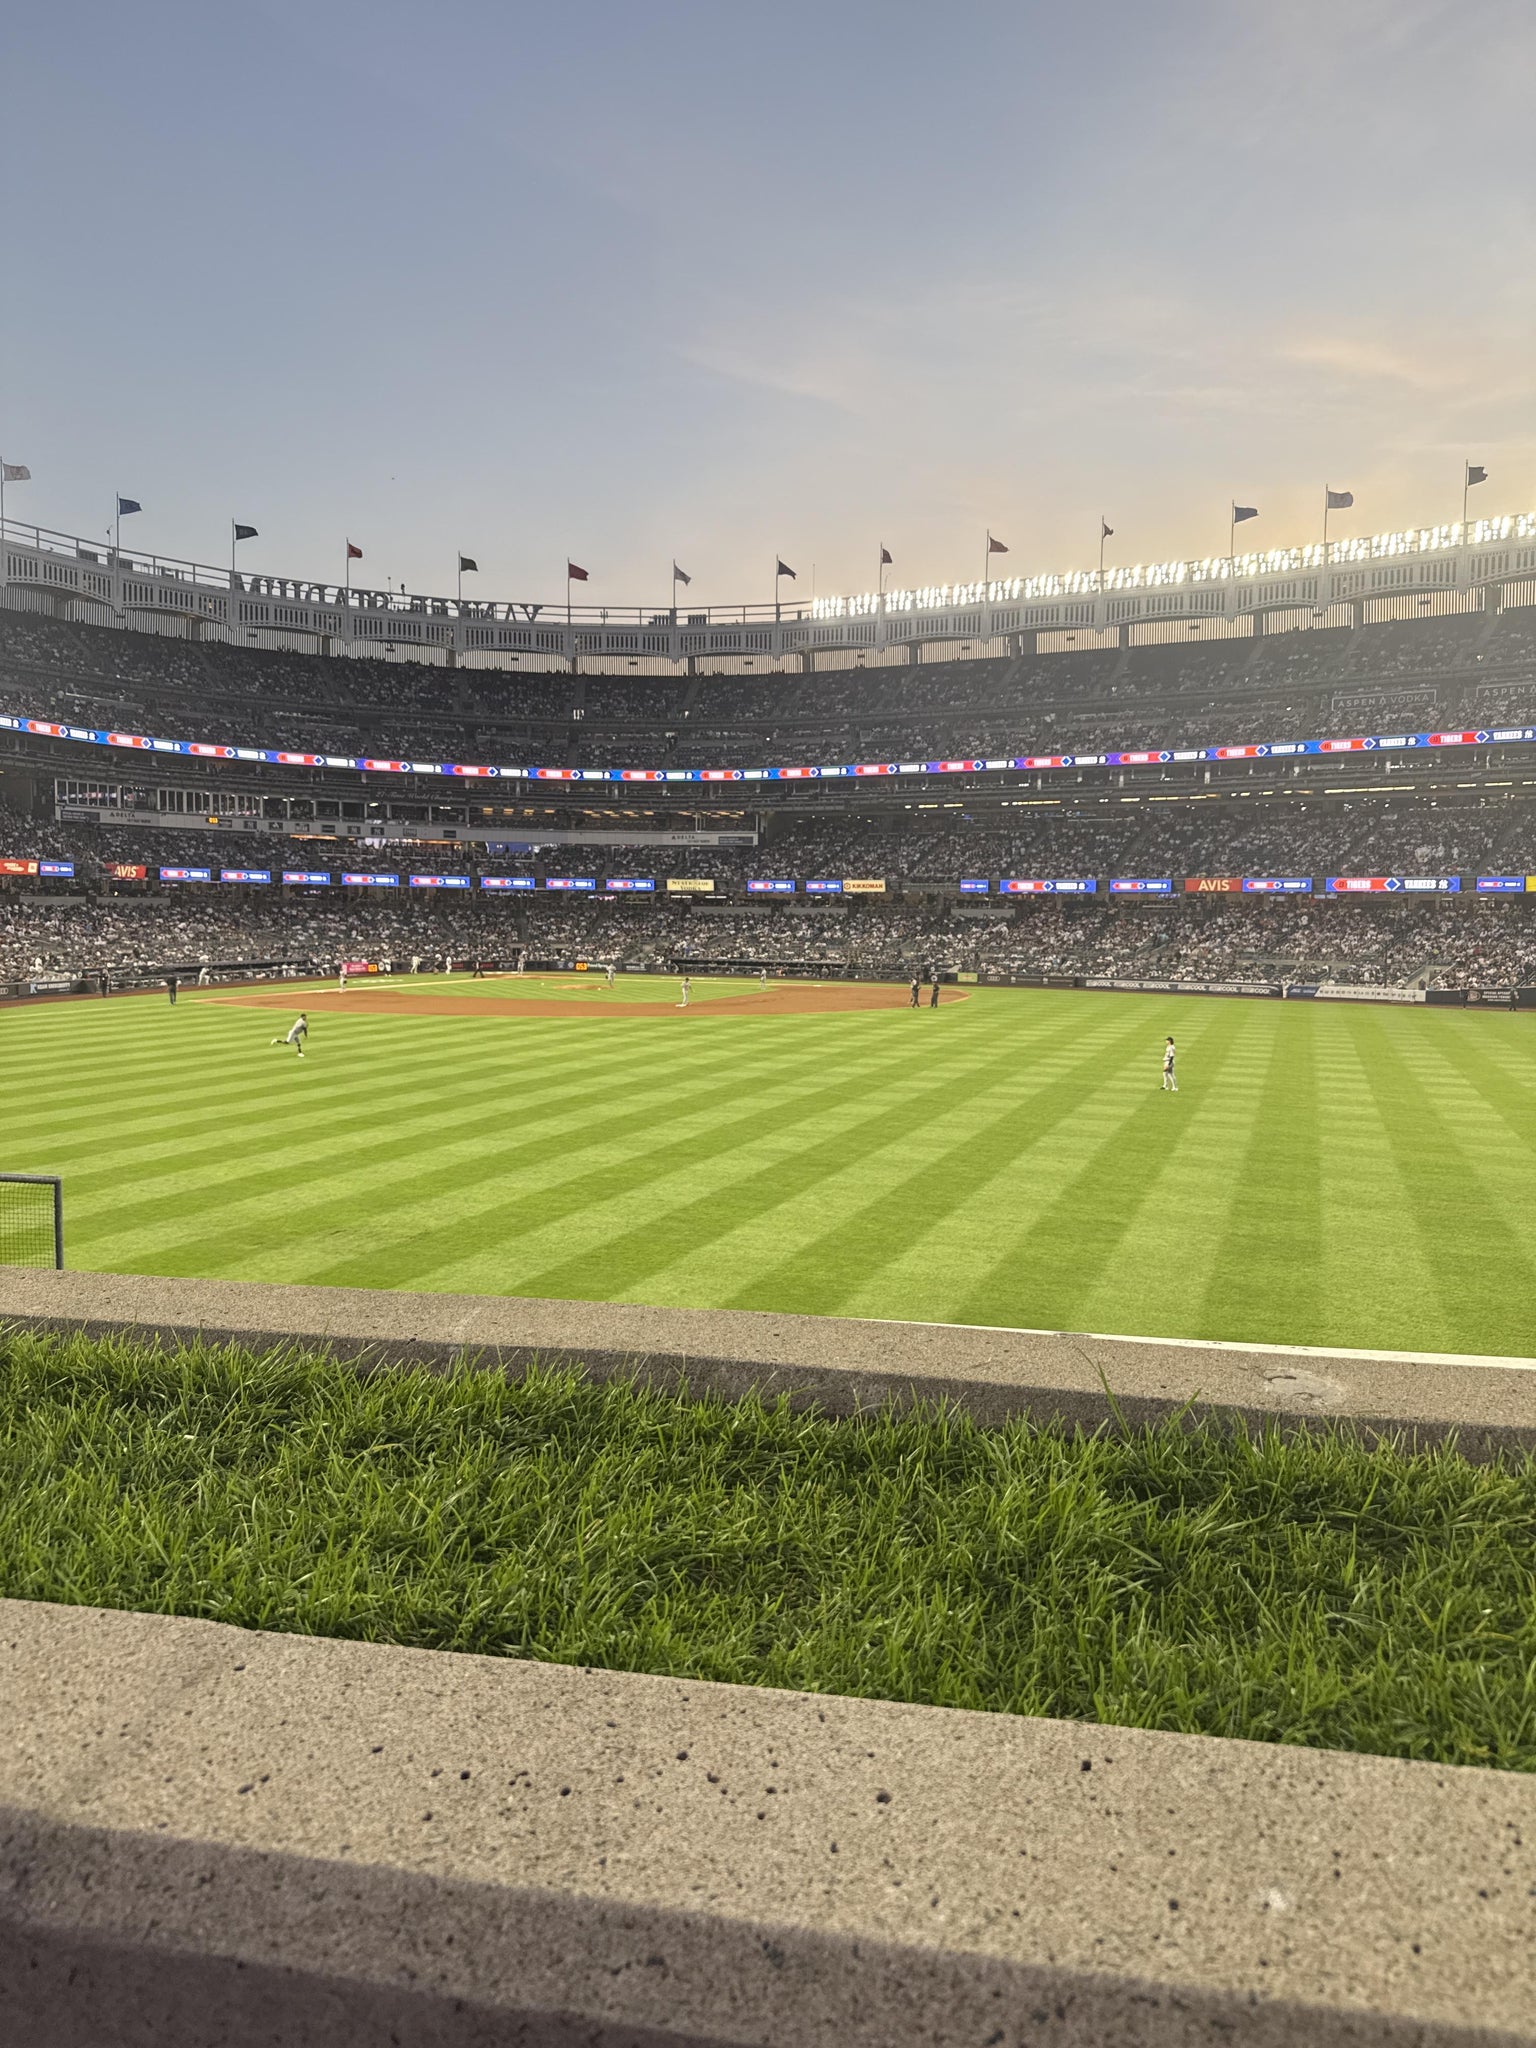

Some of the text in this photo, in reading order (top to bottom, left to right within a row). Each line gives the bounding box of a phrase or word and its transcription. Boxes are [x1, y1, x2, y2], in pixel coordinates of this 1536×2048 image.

[1483, 686, 1525, 697] ASPEN
[1338, 693, 1429, 708] ASPEN VODKA
[114, 865, 138, 878] AVIS
[1197, 880, 1230, 891] AVIS
